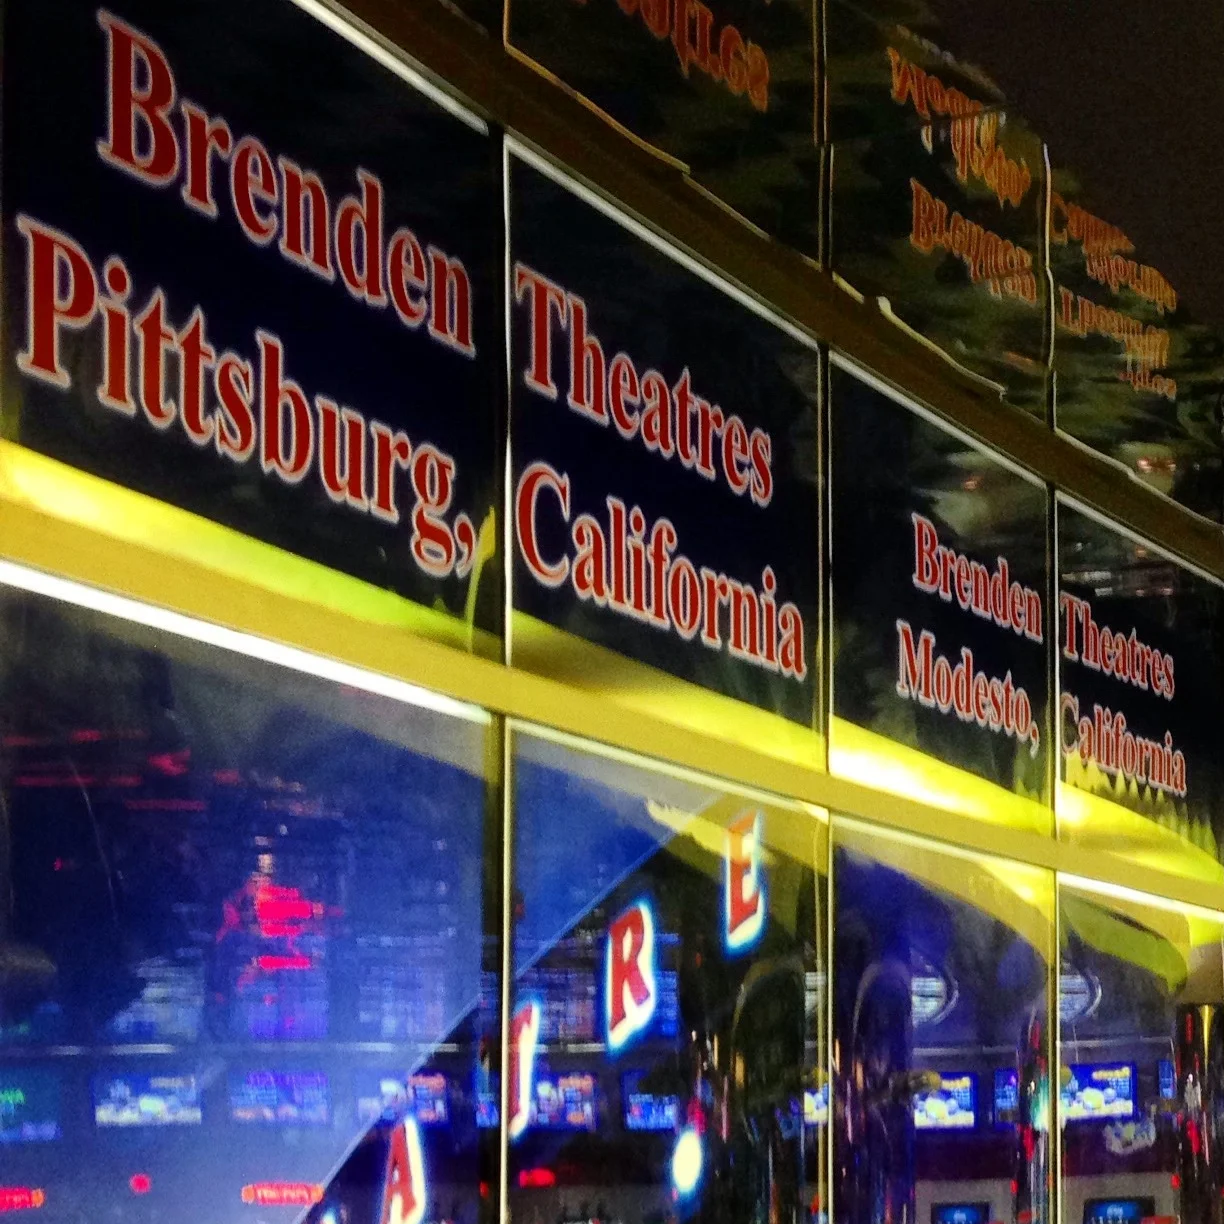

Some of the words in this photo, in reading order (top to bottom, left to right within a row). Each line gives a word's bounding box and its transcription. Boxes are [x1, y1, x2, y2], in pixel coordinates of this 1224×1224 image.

[97, 9, 476, 357] Brenden
[514, 263, 774, 507] Theatres
[15, 214, 479, 578] Pittsburg,
[516, 462, 807, 682] California
[910, 512, 1043, 644] Brenden
[1060, 590, 1175, 700] Theatres
[896, 619, 1040, 759] Modesto,
[1061, 692, 1187, 797] California
